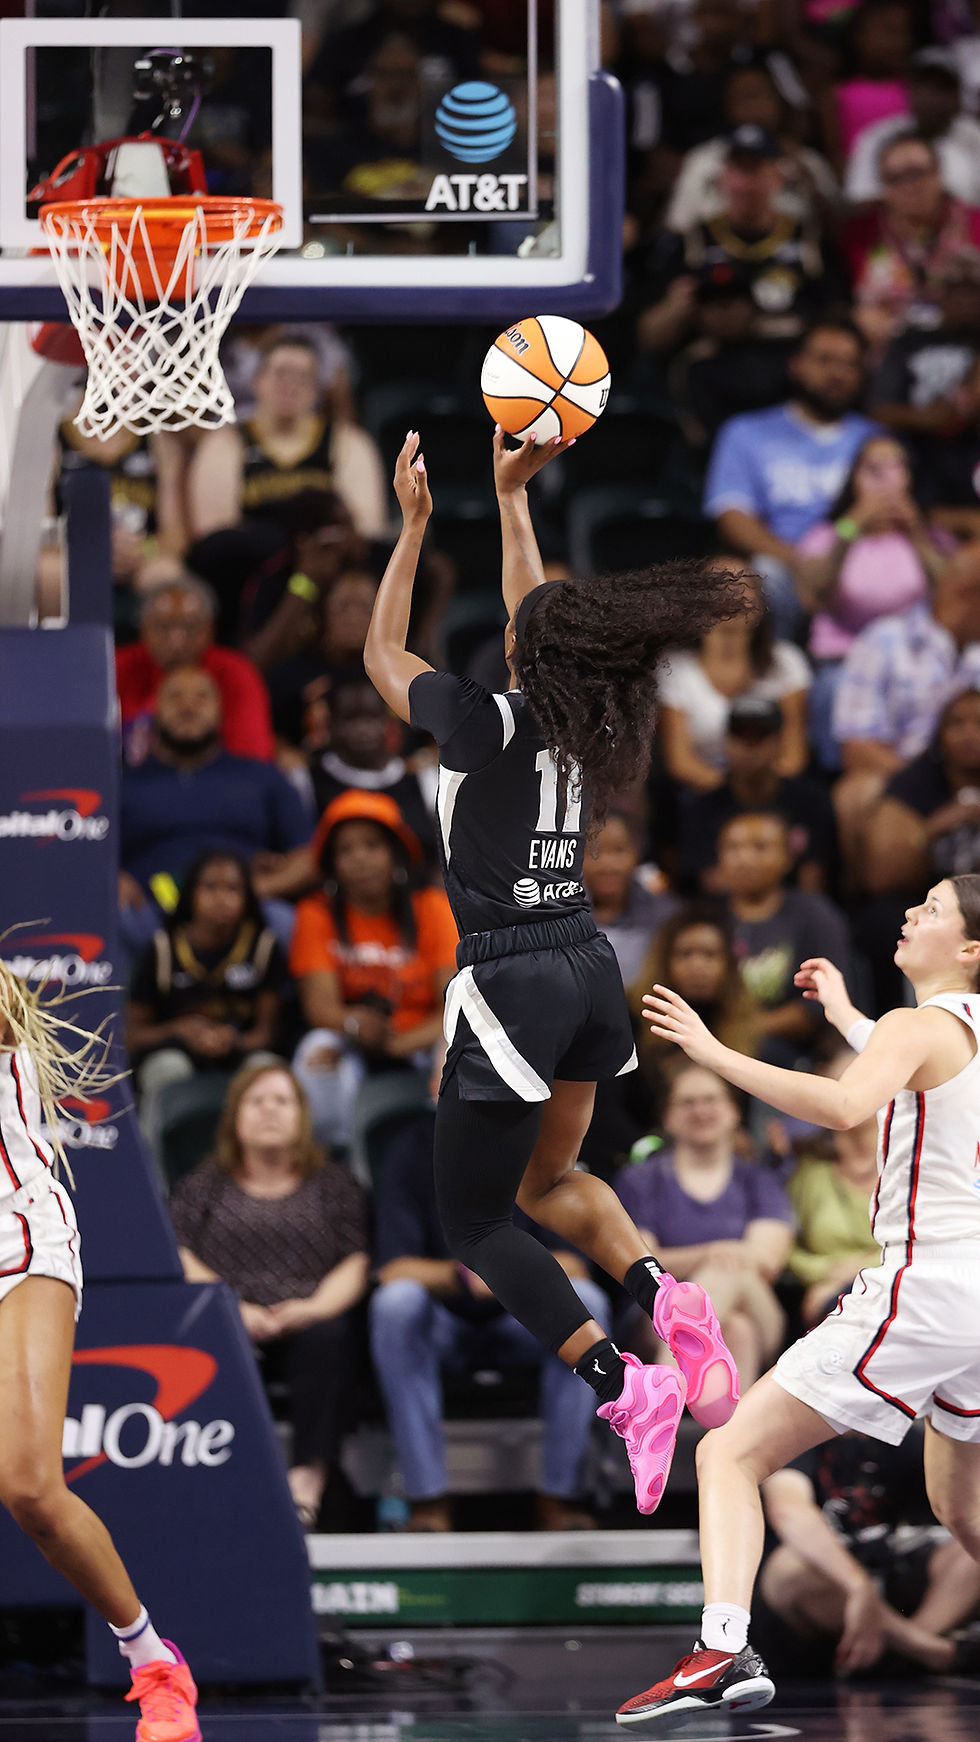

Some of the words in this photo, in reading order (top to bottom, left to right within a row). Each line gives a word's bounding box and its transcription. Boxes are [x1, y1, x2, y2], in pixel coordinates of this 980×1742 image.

[424, 173, 528, 211] AT&T
[504, 324, 531, 356] son
[528, 838, 577, 869] EVANS
